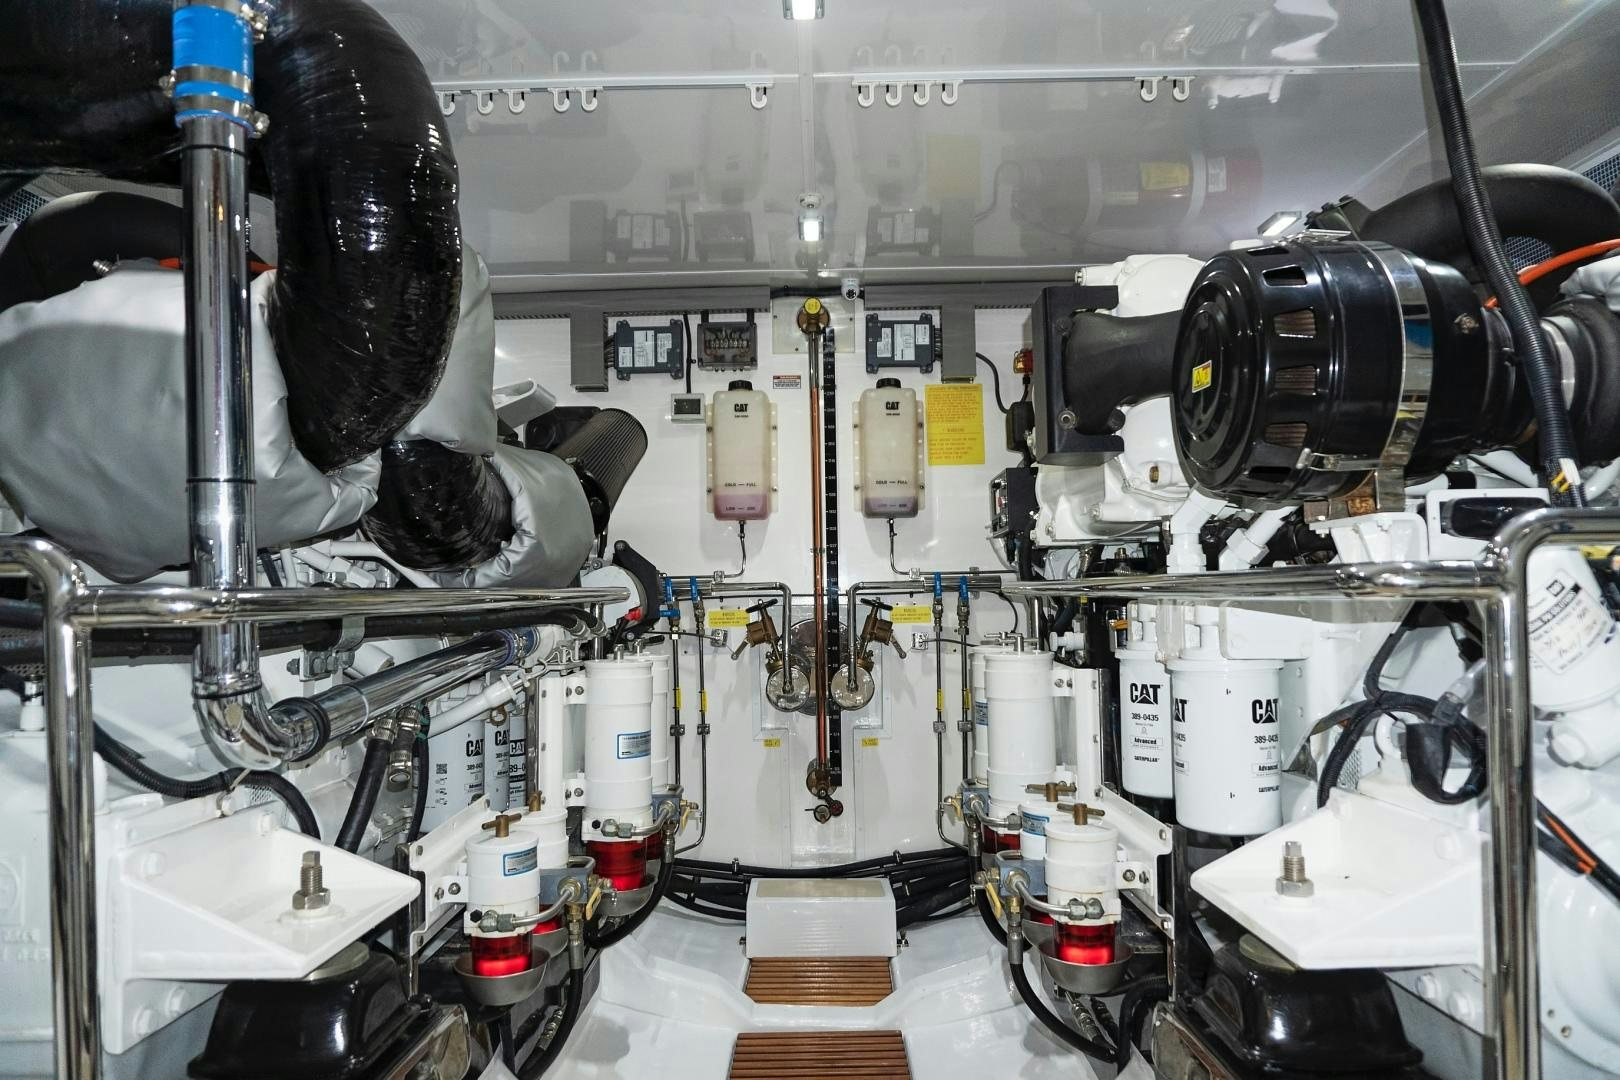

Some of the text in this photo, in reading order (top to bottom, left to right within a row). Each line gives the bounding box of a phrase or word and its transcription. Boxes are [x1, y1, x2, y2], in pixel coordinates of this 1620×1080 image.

[734, 403, 748, 412] CAT
[886, 401, 900, 410] CAT
[1130, 683, 1161, 705] CAT
[1131, 712, 1159, 722] 389-0435
[1173, 698, 1187, 723] AT
[1251, 698, 1279, 724] CAT
[495, 730, 509, 746] CA
[1134, 737, 1157, 745] Advanced
[466, 739, 484, 757] CAT
[510, 742, 525, 755] CAT
